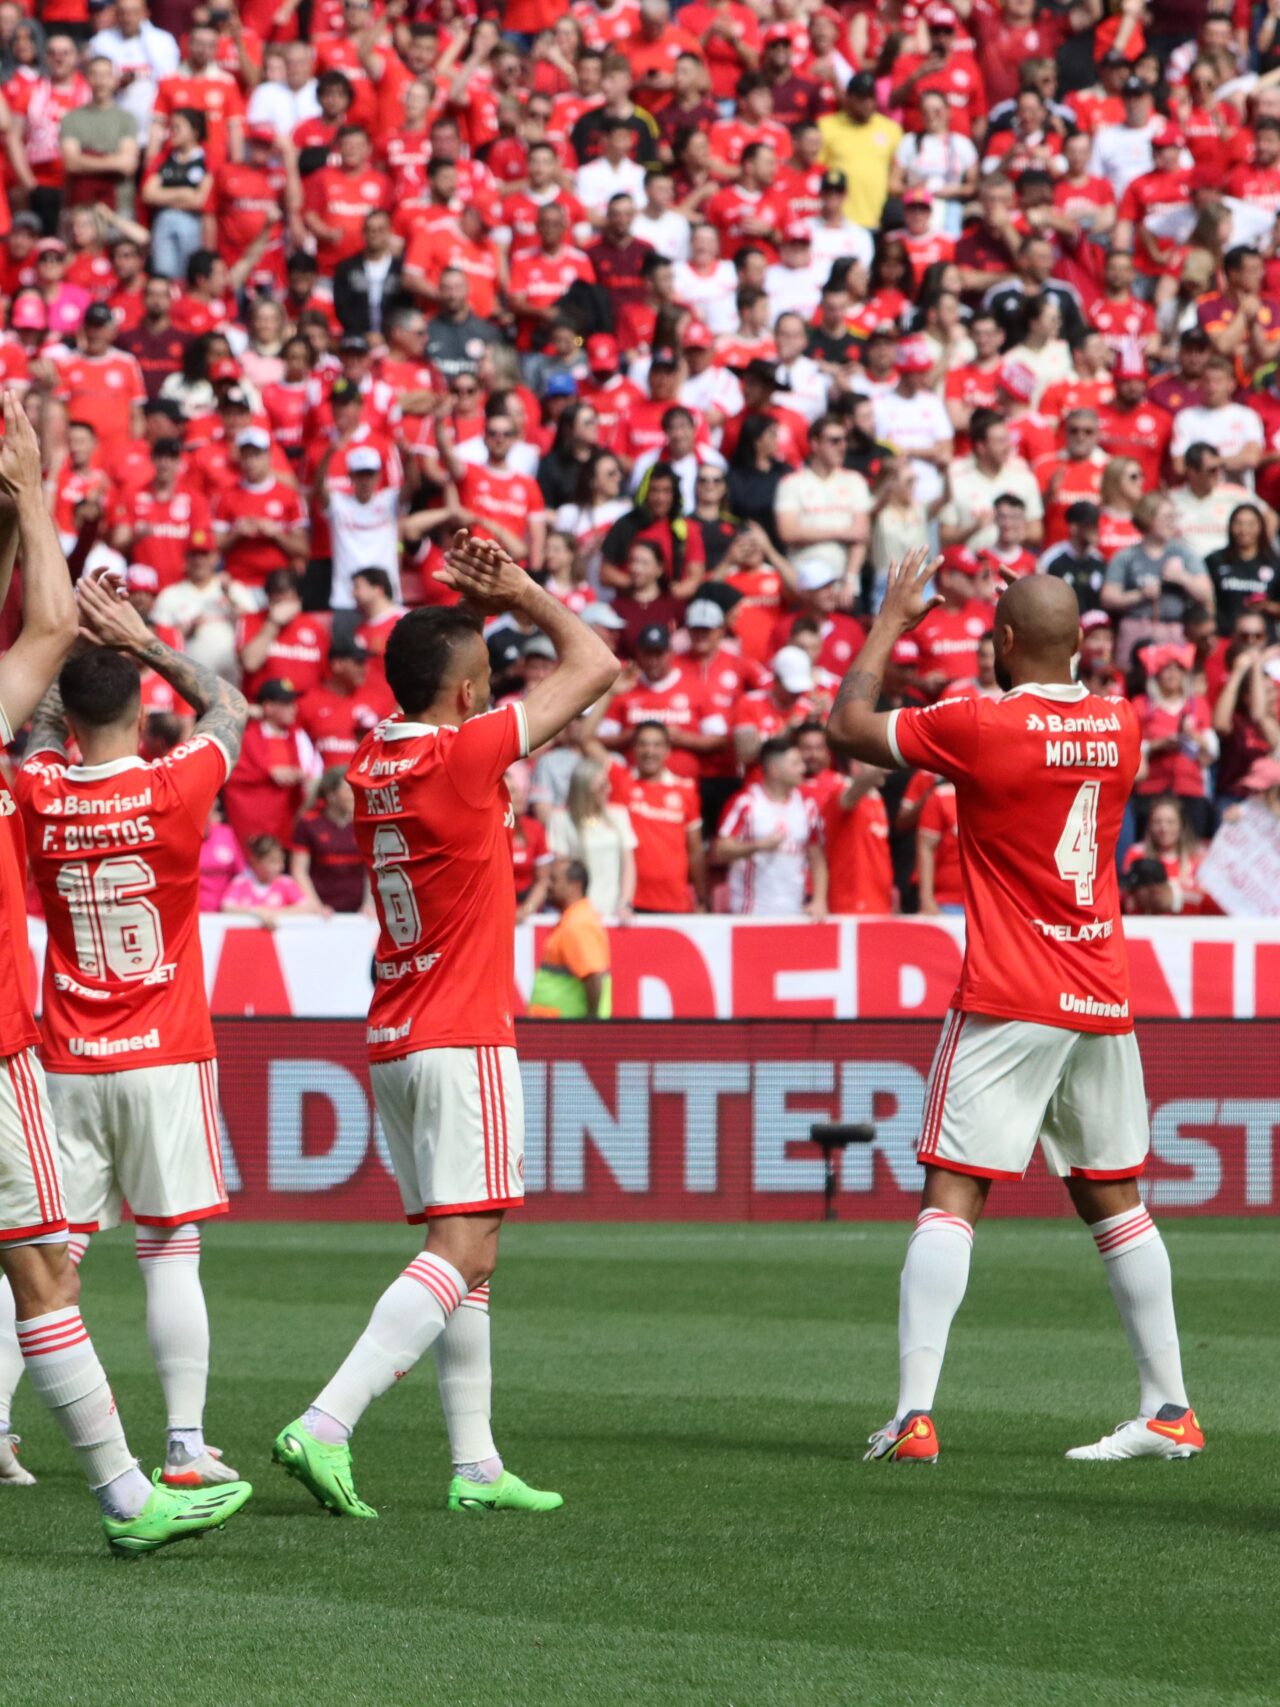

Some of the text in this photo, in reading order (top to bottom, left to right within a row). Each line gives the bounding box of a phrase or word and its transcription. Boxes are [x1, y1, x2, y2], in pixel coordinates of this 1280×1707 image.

[1046, 711, 1121, 733] Banrisul
[1046, 739, 1119, 768] MOLEDO
[64, 788, 152, 816] Banrisul
[42, 815, 156, 852] F. BUSTOS
[1053, 780, 1101, 906] 4
[372, 823, 423, 951] 6
[55, 854, 165, 983] 16
[1059, 991, 1129, 1018] Unimed
[68, 1028, 160, 1057] Unimed
[520, 1058, 926, 1194] INTER
